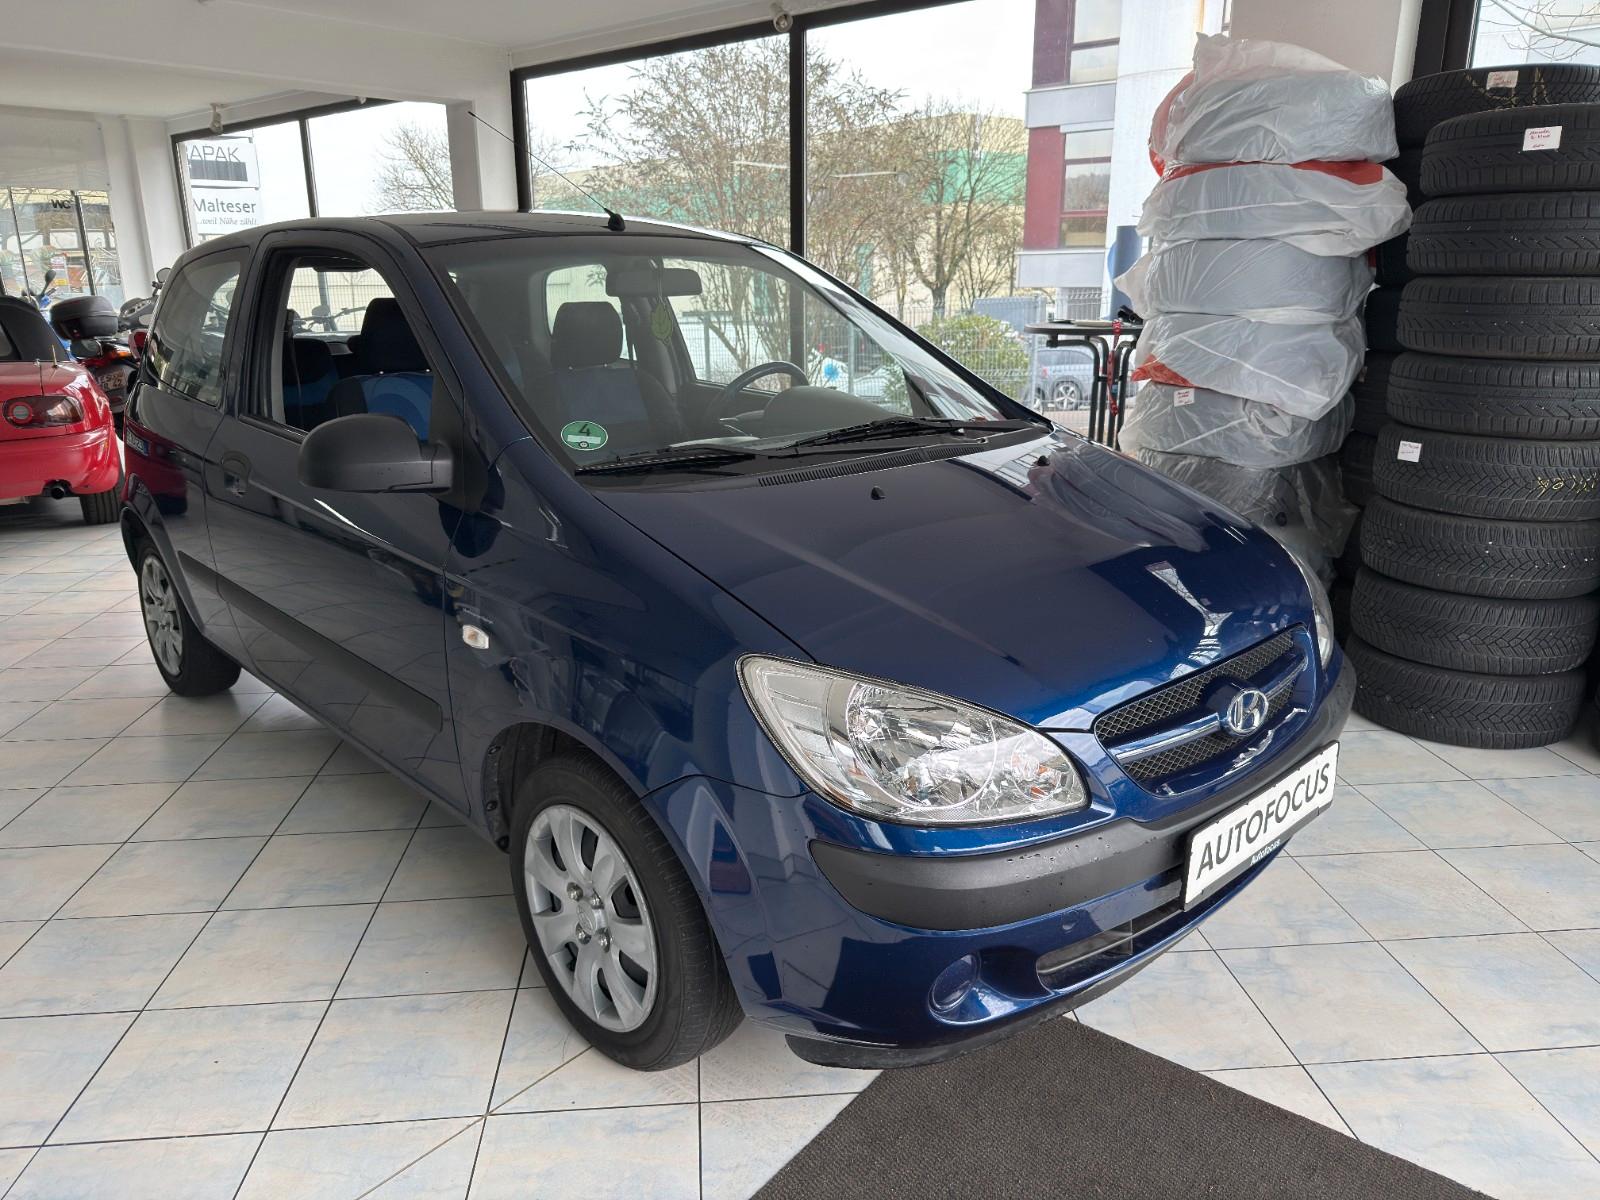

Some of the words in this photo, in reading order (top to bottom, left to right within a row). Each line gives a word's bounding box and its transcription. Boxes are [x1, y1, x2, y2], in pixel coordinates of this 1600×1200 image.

[51, 199, 71, 209] WC
[193, 198, 257, 213] Malteser
[579, 423, 591, 436] 4
[1196, 763, 1330, 880] AUTOFOCUS
